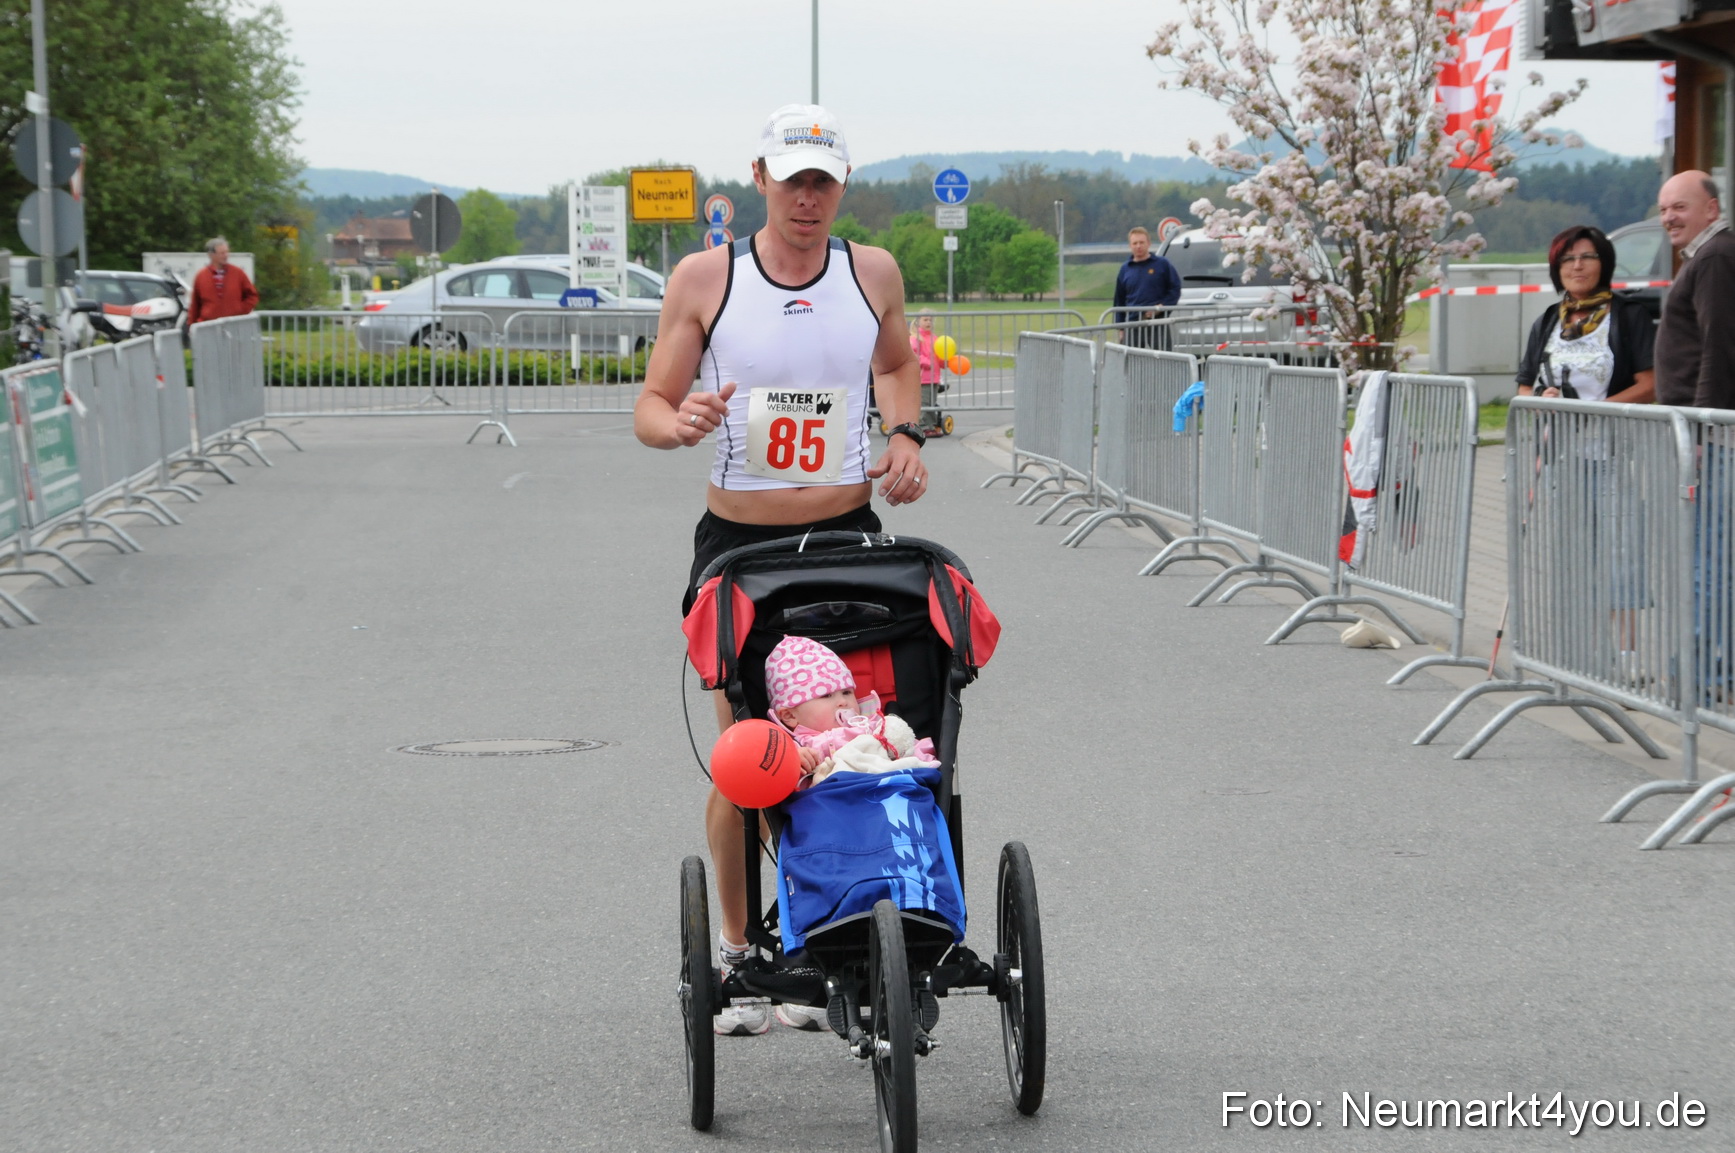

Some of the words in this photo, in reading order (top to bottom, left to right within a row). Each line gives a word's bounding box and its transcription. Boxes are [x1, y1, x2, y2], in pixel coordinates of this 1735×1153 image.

[784, 125, 835, 141] IRONMAN
[637, 188, 689, 201] Neumarkt
[566, 296, 594, 308] VOLVO
[783, 307, 814, 316] skinfit
[766, 392, 814, 404] MEYER
[766, 403, 814, 413] WERBUNG
[766, 417, 826, 473] 85
